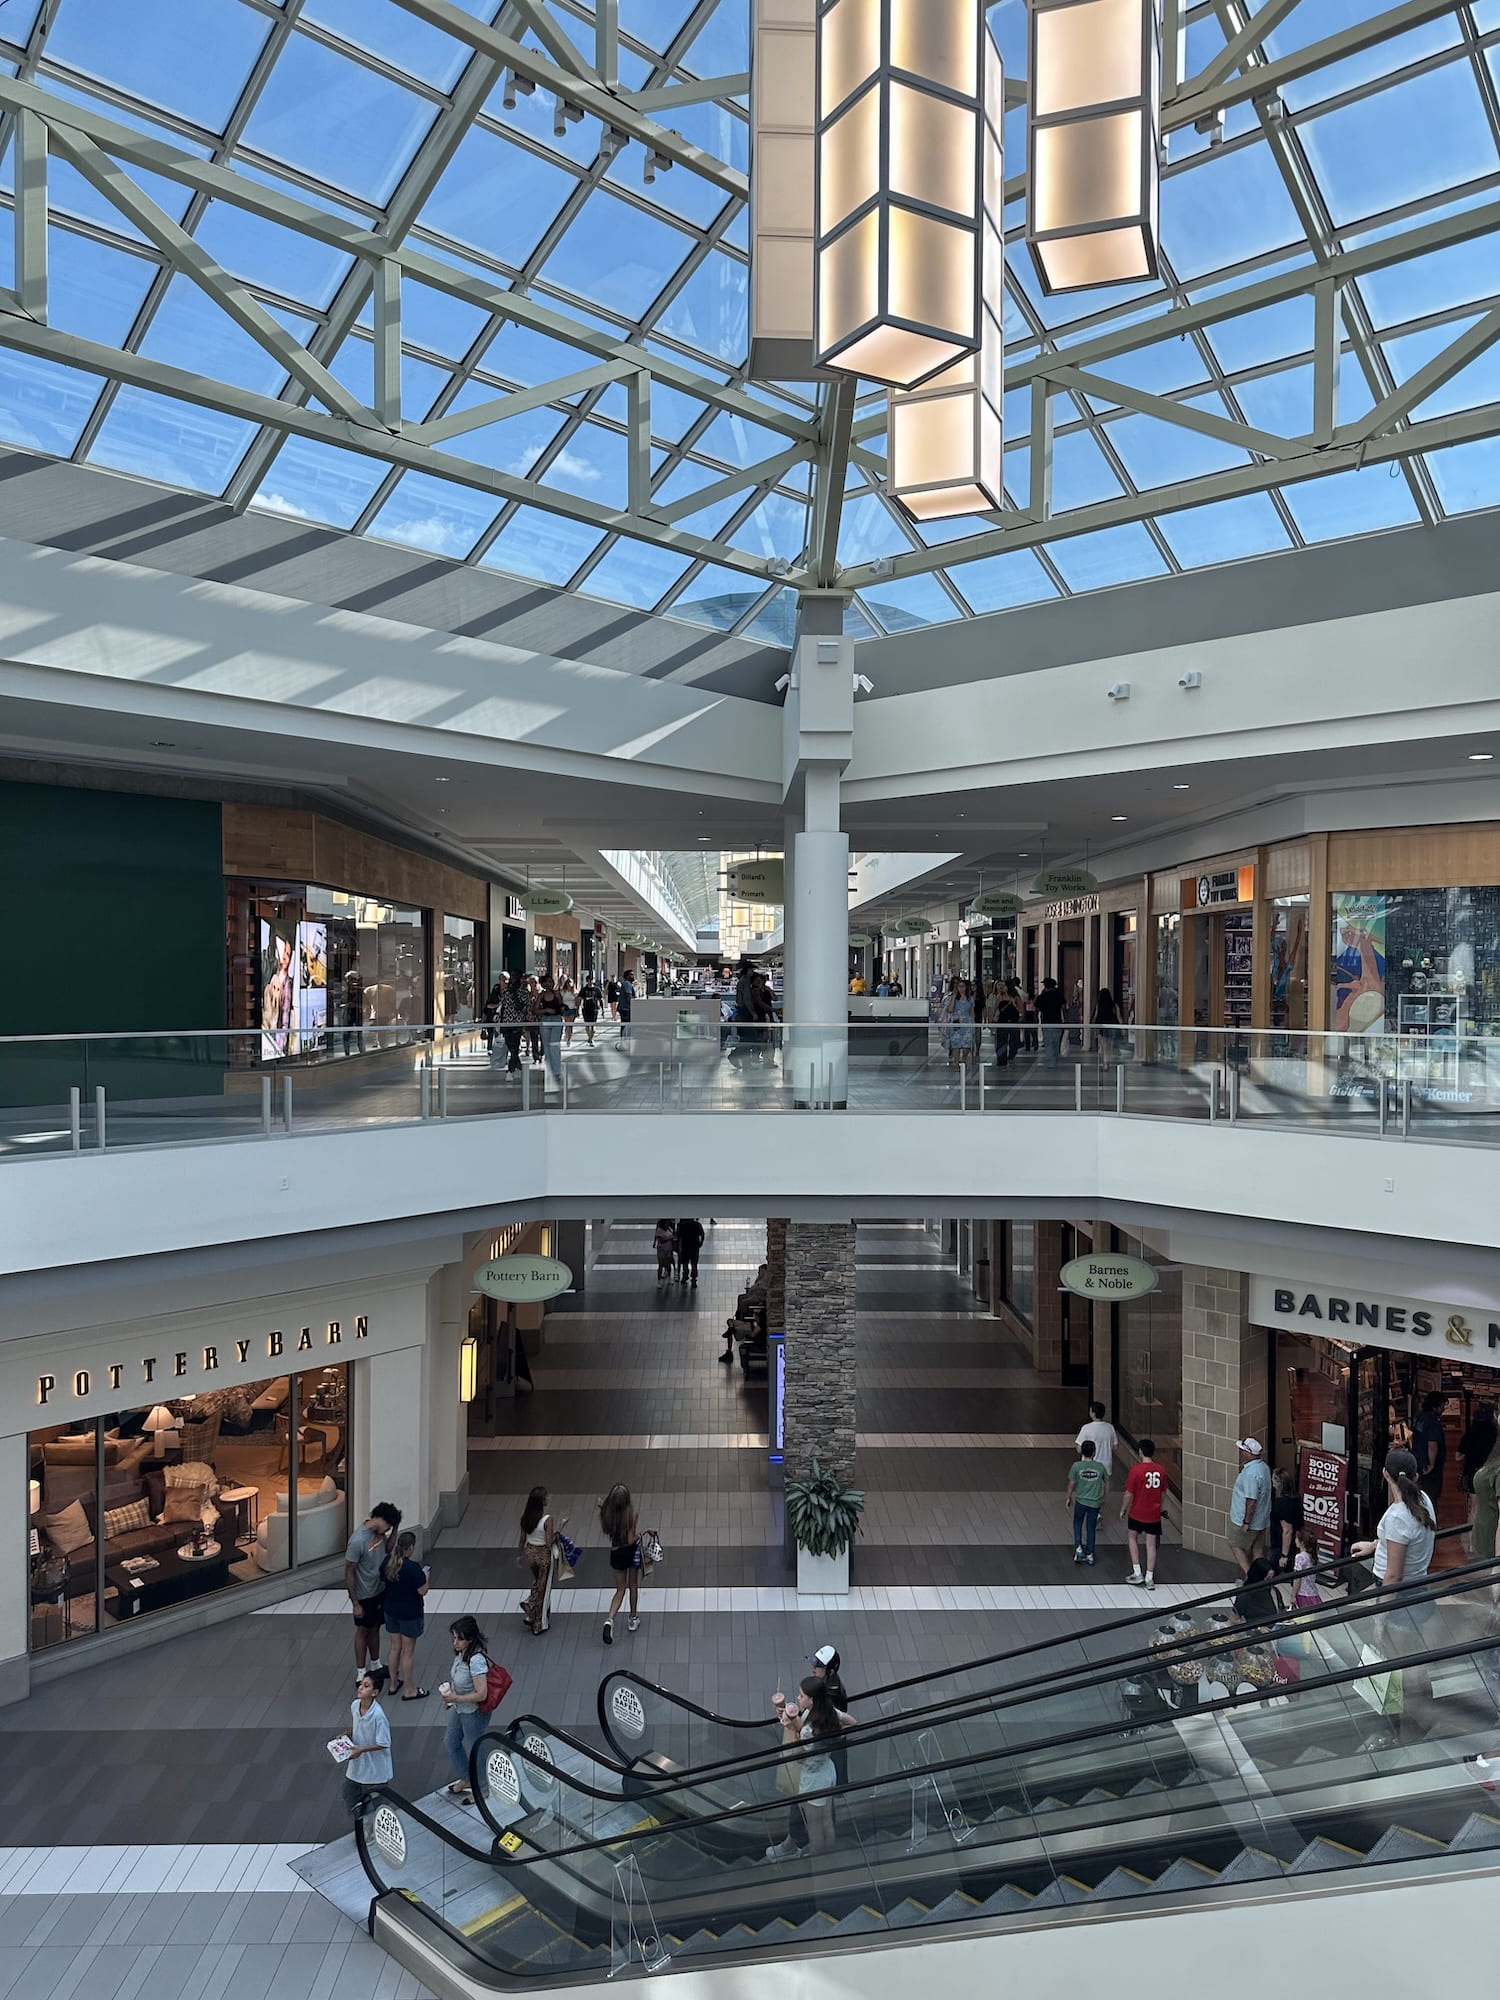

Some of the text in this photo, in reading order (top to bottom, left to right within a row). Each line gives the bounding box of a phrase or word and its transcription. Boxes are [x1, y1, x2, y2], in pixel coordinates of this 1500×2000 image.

[1048, 874, 1083, 882] Franklin
[1045, 884, 1058, 892] Toy
[486, 1270, 560, 1284] Pottery Barn
[1089, 1264, 1129, 1276] Barnes
[1084, 1278, 1133, 1289] & Noble
[1274, 1289, 1432, 1336] BARNES
[1445, 1314, 1473, 1346] &
[1309, 1458, 1339, 1473] BOOK
[1144, 1471, 1161, 1489] 36
[1308, 1467, 1339, 1481] HAUL
[1302, 1493, 1340, 1515] 50%
[618, 1693, 638, 1708] YOUR
[620, 1688, 635, 1700] FOR
[614, 1697, 642, 1715] SAFETY
[528, 1741, 548, 1758] YOUR
[531, 1737, 545, 1749] FOR
[493, 1758, 513, 1776] YOUR
[495, 1753, 510, 1767] FOR
[489, 1763, 517, 1784] SAFETY
[380, 1814, 400, 1834] YOUR
[383, 1809, 397, 1824] FOR
[376, 1819, 403, 1843] SAFETY
